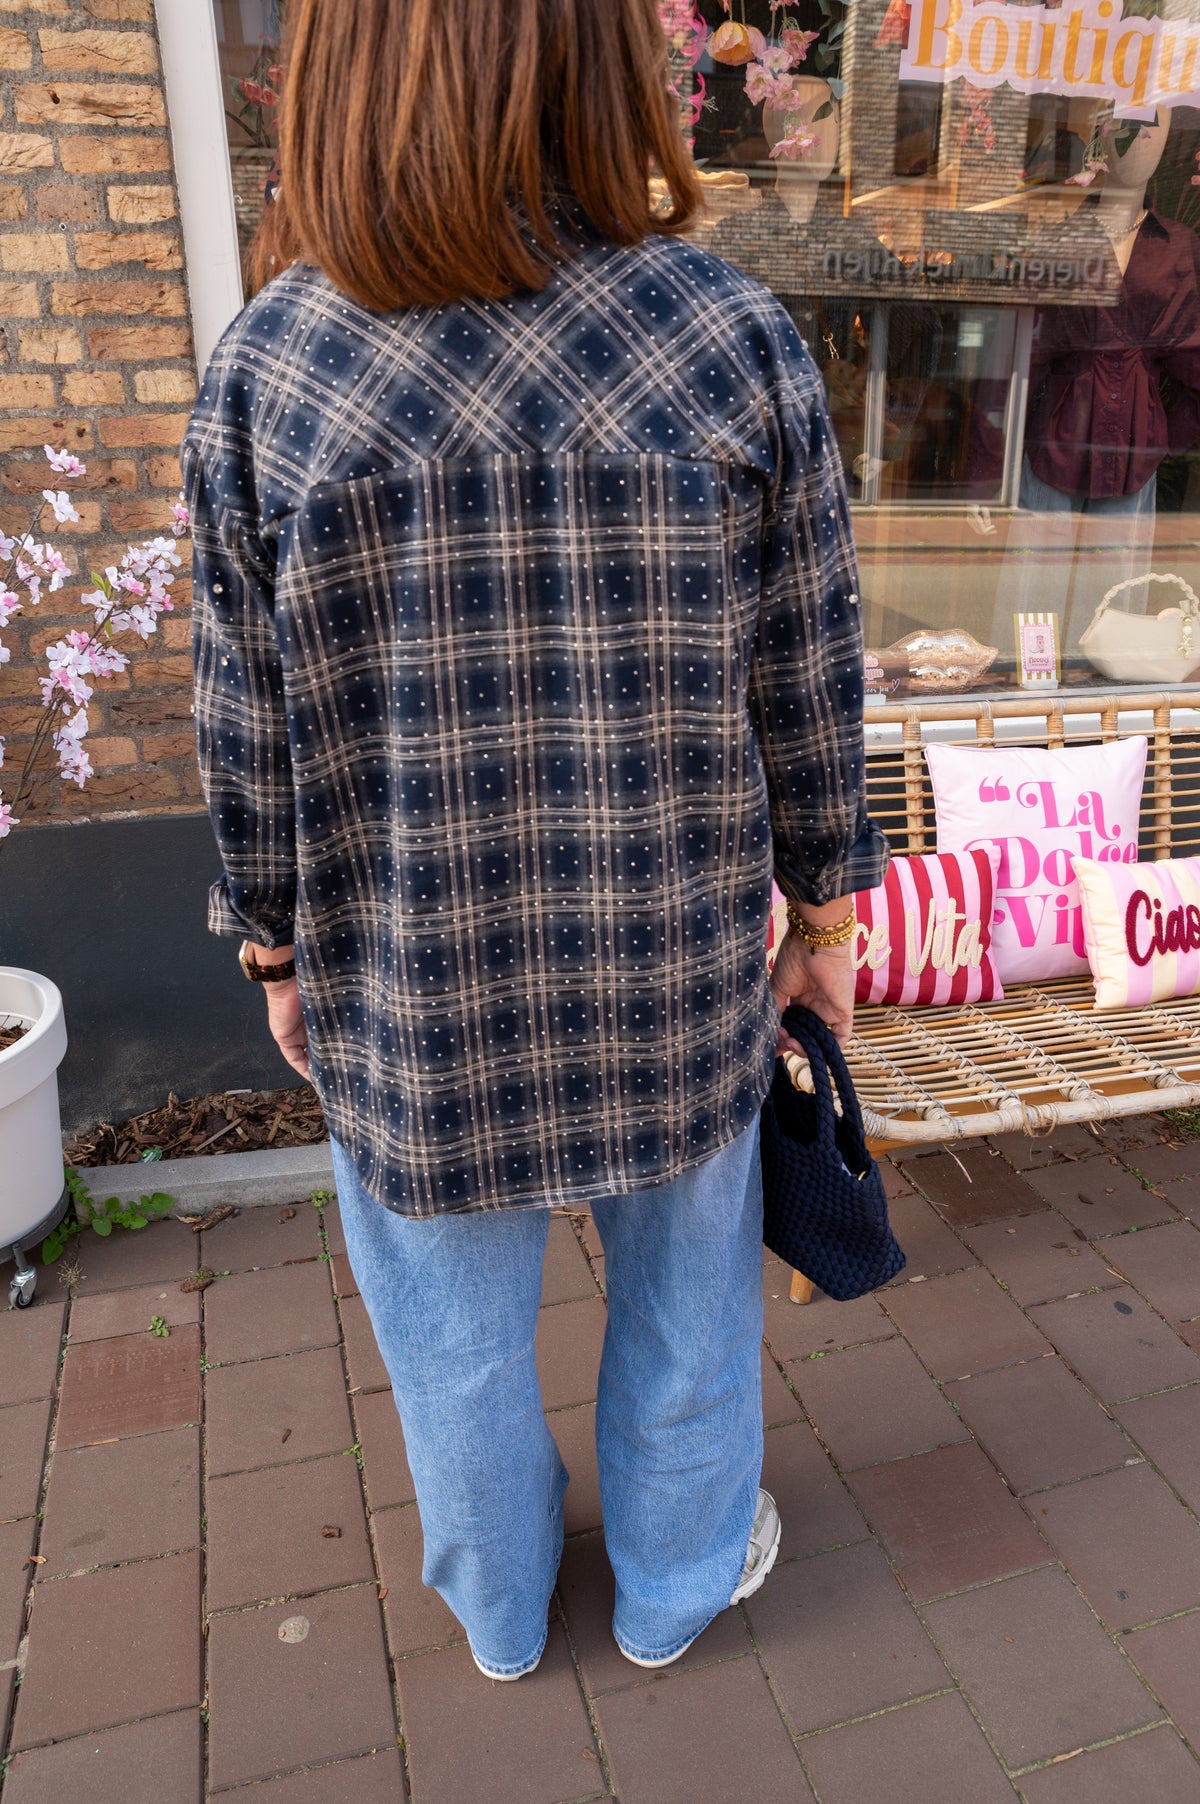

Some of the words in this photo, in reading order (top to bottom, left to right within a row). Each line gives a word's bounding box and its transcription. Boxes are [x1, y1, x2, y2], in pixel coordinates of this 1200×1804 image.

[906, 897, 983, 977] Vita
[993, 893, 1088, 959] Vit
[1125, 889, 1200, 967] Ciao
